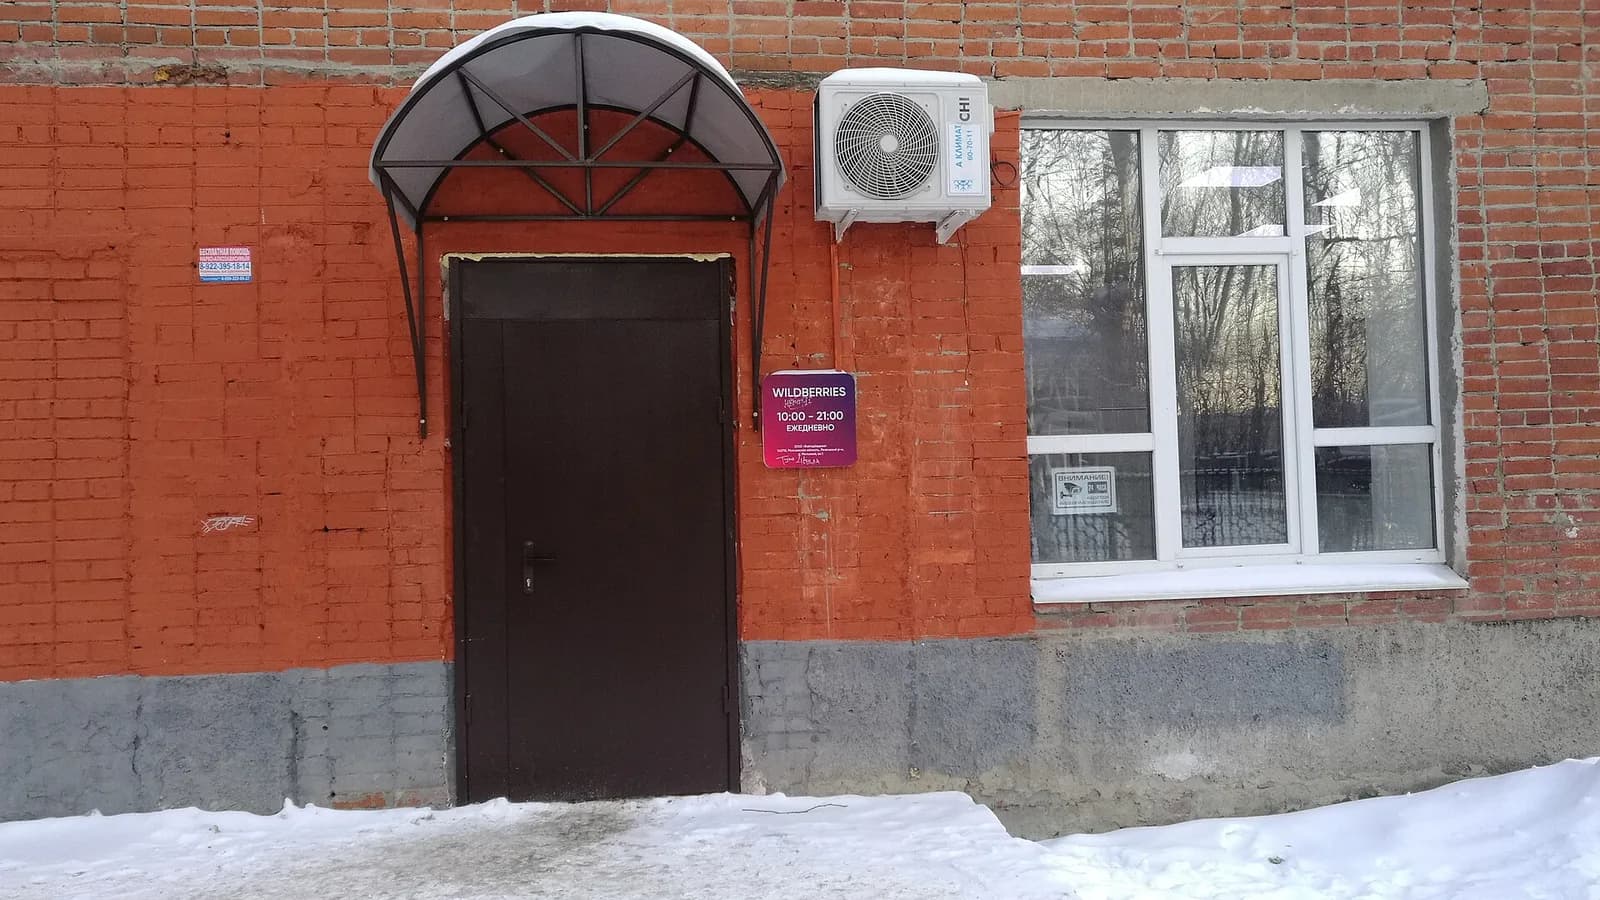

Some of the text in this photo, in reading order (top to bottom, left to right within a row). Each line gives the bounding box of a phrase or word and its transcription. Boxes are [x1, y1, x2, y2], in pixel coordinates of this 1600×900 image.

[955, 125, 963, 158] КЛИМАТ
[199, 262, 250, 270] 8-922-395-18-14
[772, 386, 847, 398] WILDBERRIES
[777, 411, 806, 421] 10:00
[816, 411, 844, 421] 21:00
[786, 424, 835, 432] ЕЖЕДНЕВНО
